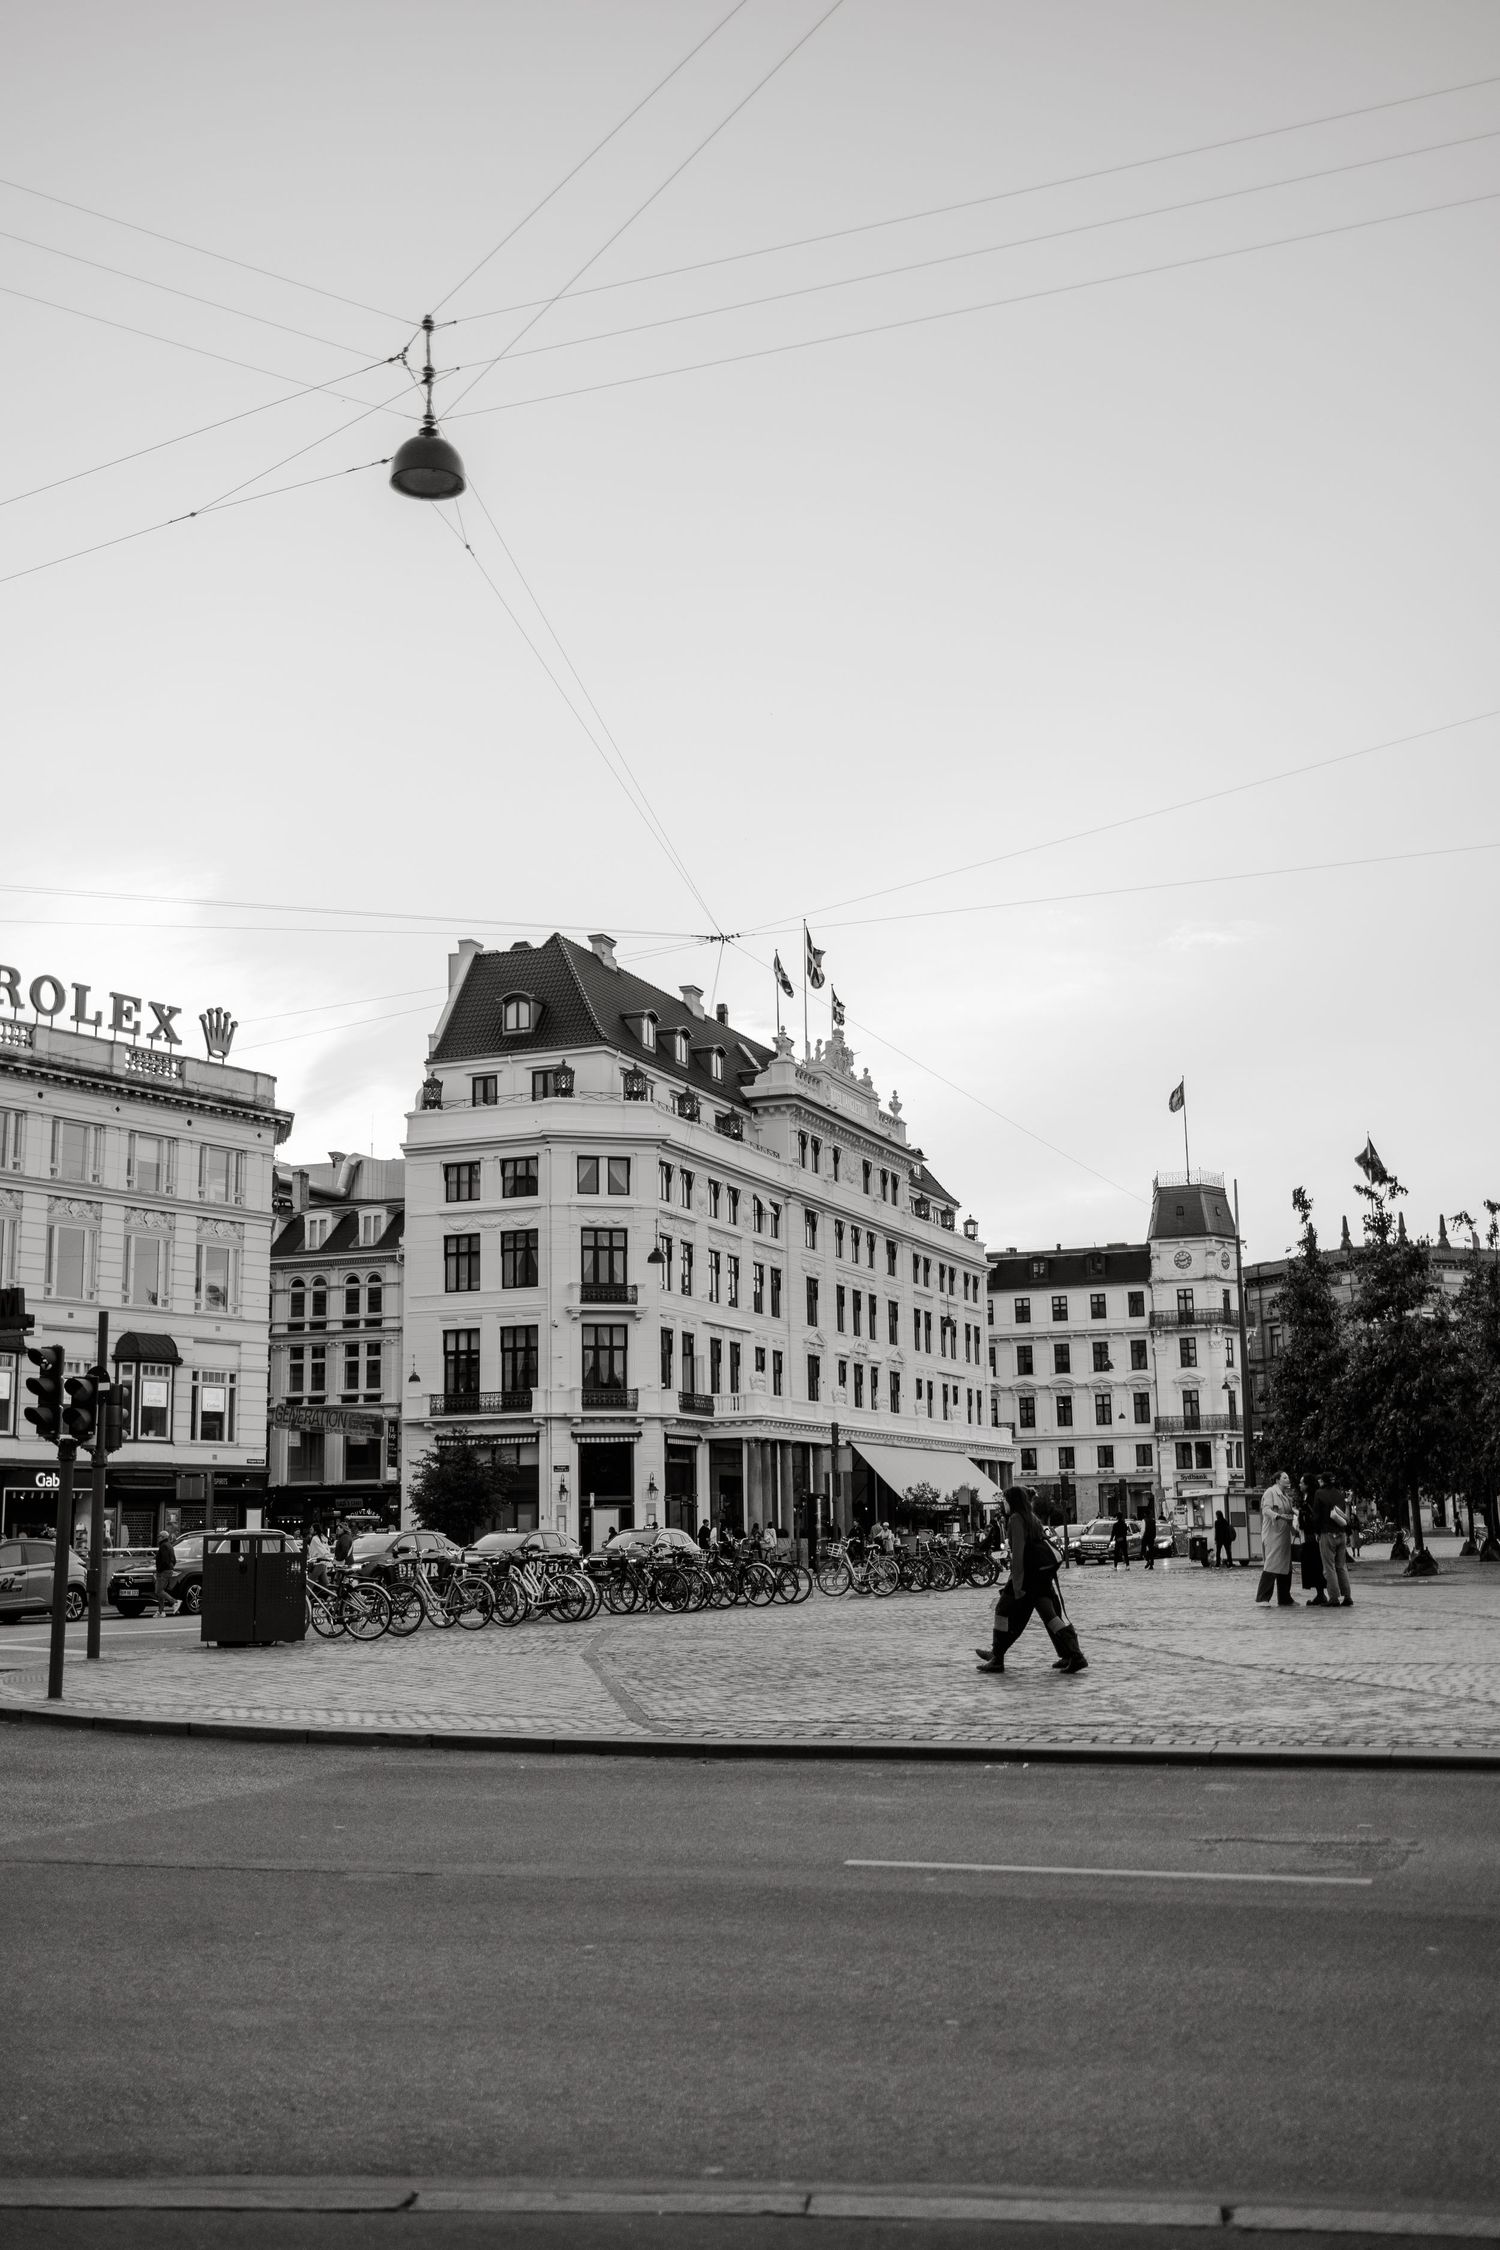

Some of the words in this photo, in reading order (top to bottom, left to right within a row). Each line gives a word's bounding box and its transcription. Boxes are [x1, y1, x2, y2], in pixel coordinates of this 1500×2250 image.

[0, 965, 183, 1045] ROLEX
[274, 1404, 347, 1429] GENERATION
[35, 1472, 61, 1487] Gab
